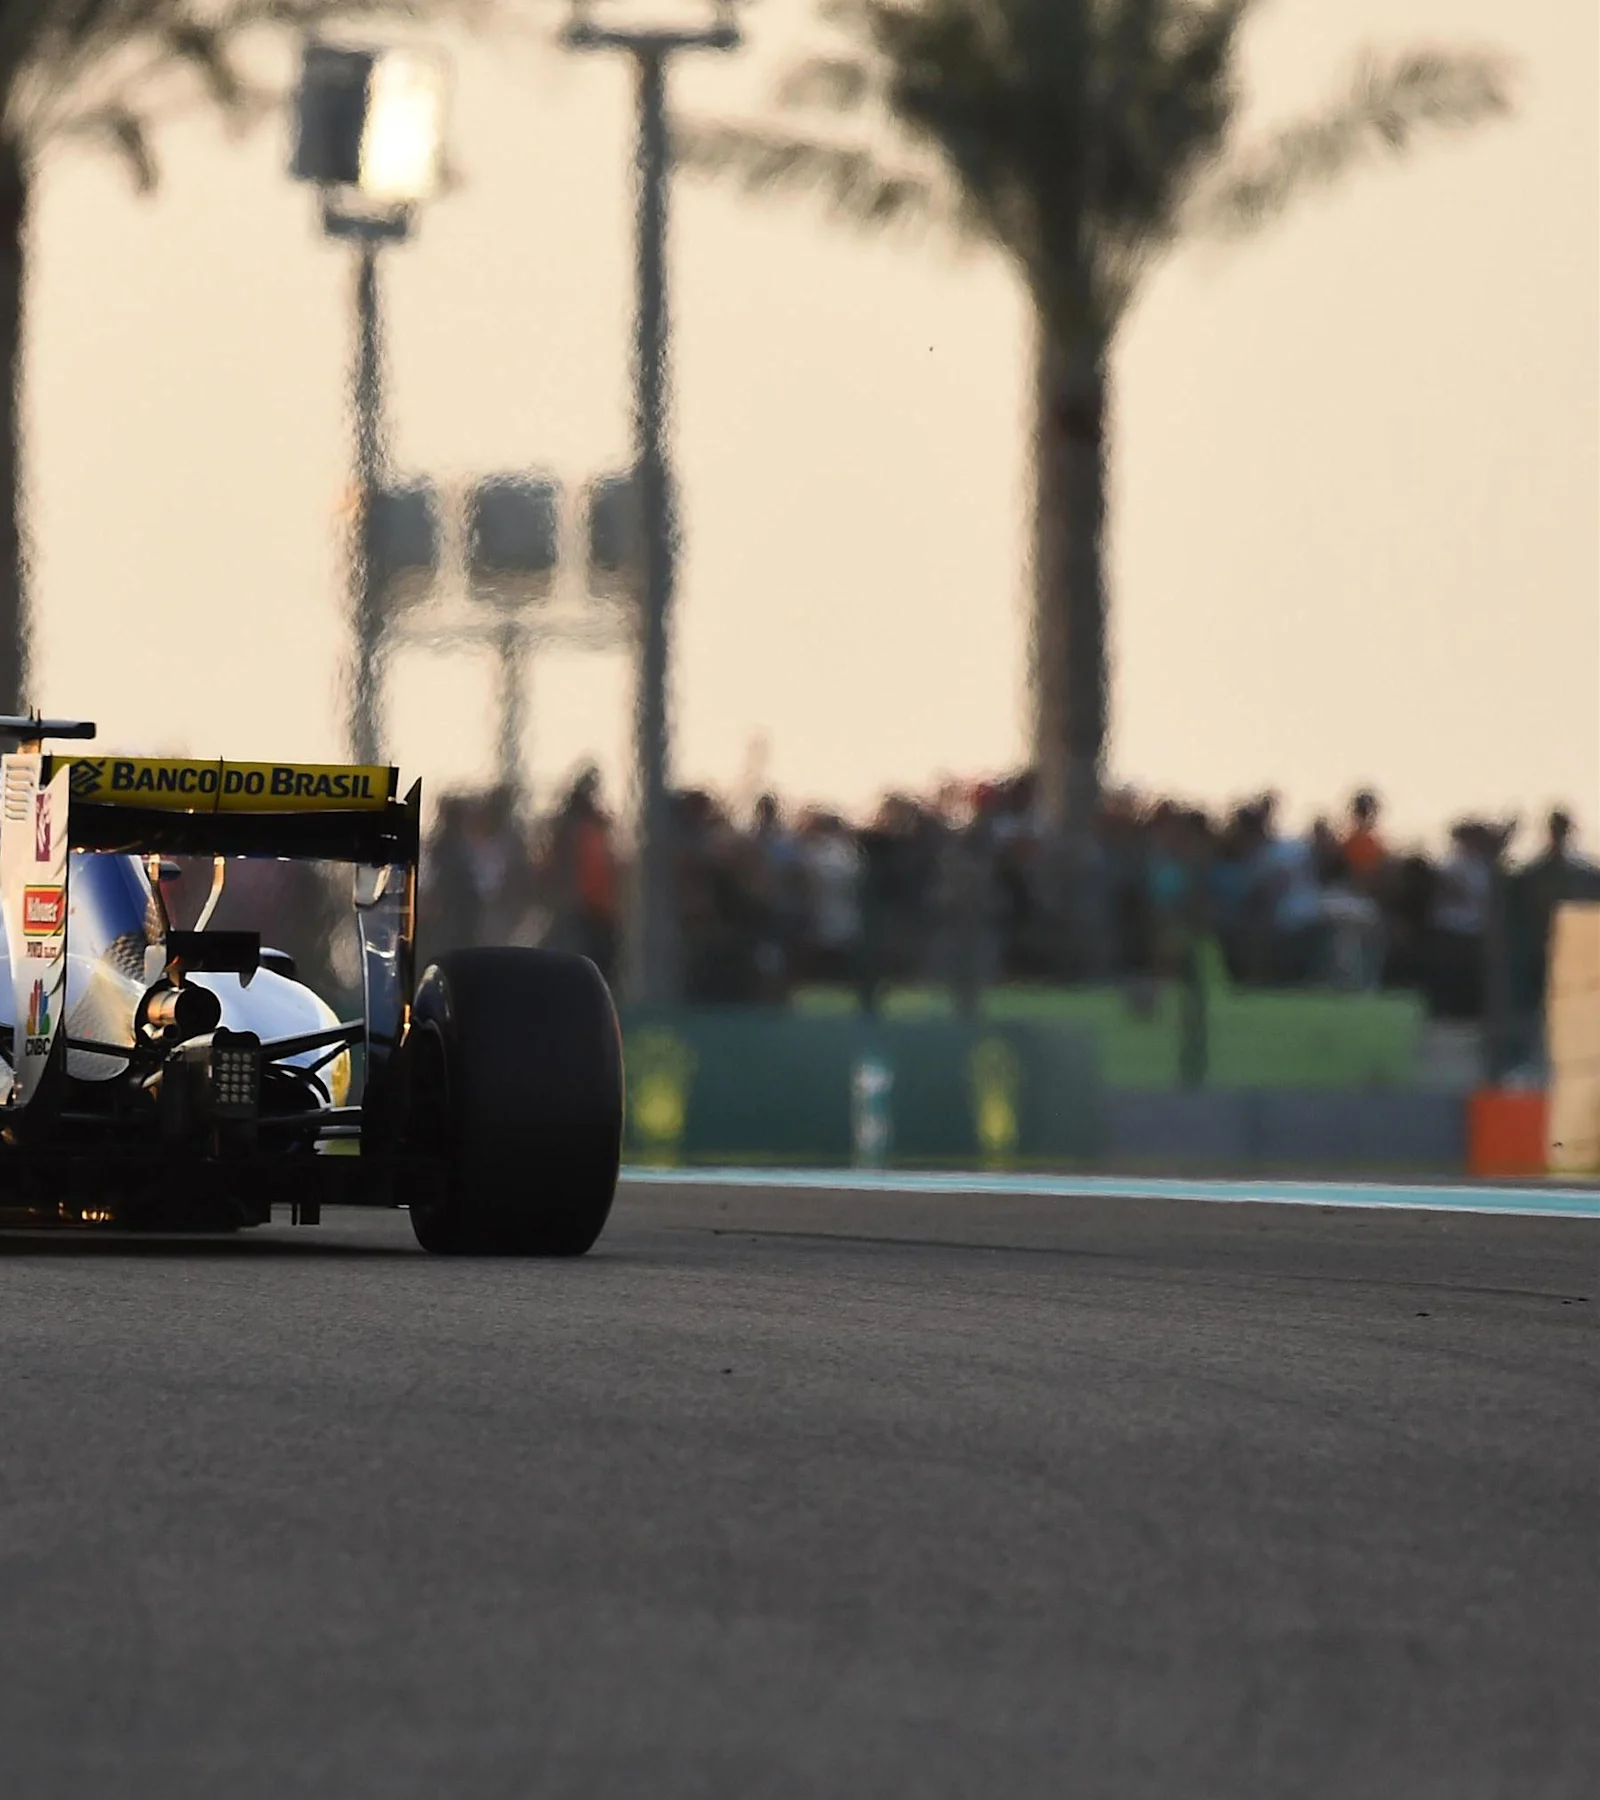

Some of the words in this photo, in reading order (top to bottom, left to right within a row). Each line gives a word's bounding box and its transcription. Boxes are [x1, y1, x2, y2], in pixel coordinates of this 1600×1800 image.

[111, 761, 218, 793] BANCO
[223, 769, 265, 795] DO
[270, 767, 375, 799] BRASIL
[25, 1038, 50, 1056] CNBC
